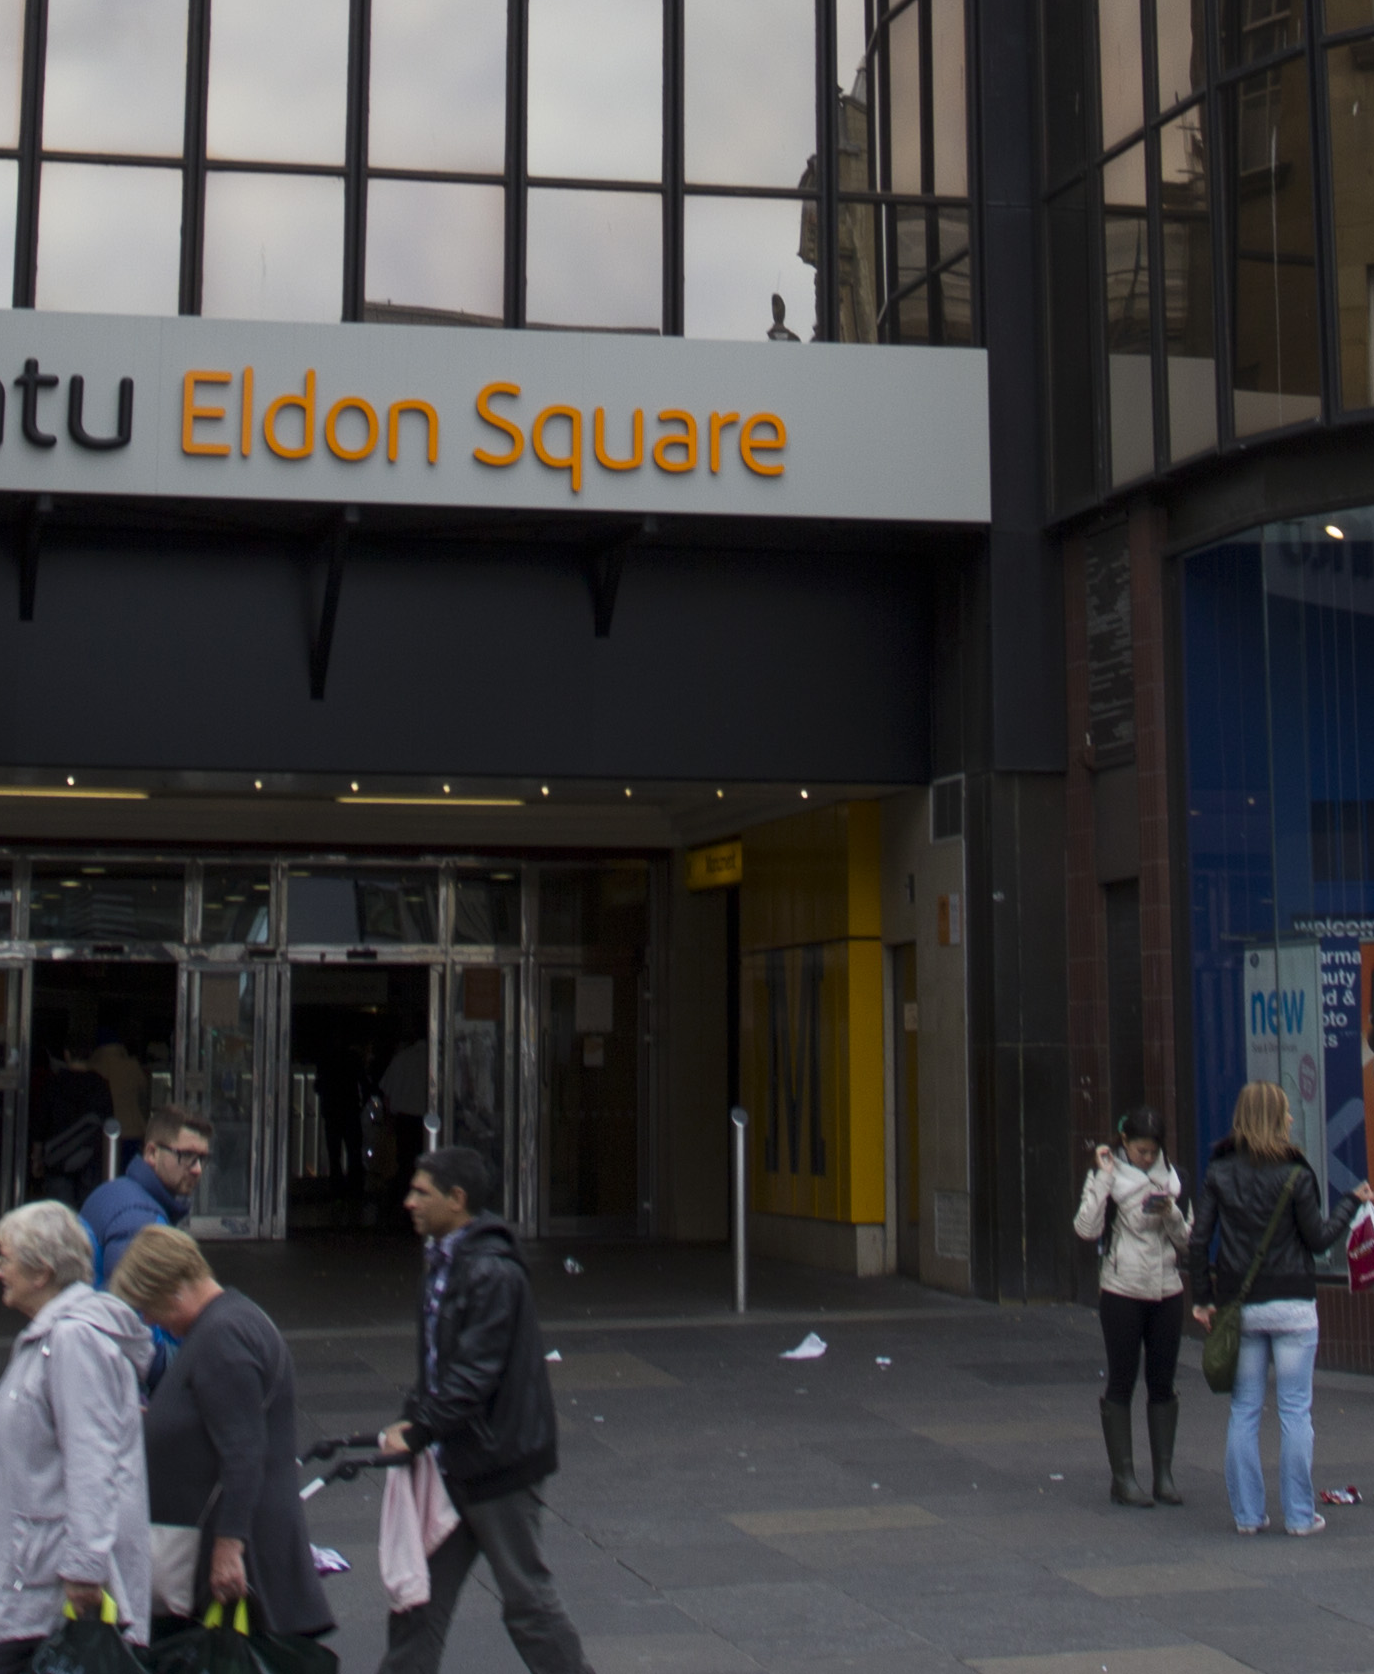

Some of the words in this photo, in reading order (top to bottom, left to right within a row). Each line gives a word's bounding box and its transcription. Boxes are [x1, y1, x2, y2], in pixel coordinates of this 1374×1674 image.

[181, 365, 439, 464] Eldon
[473, 381, 787, 493] Square
[1251, 989, 1305, 1036] new
